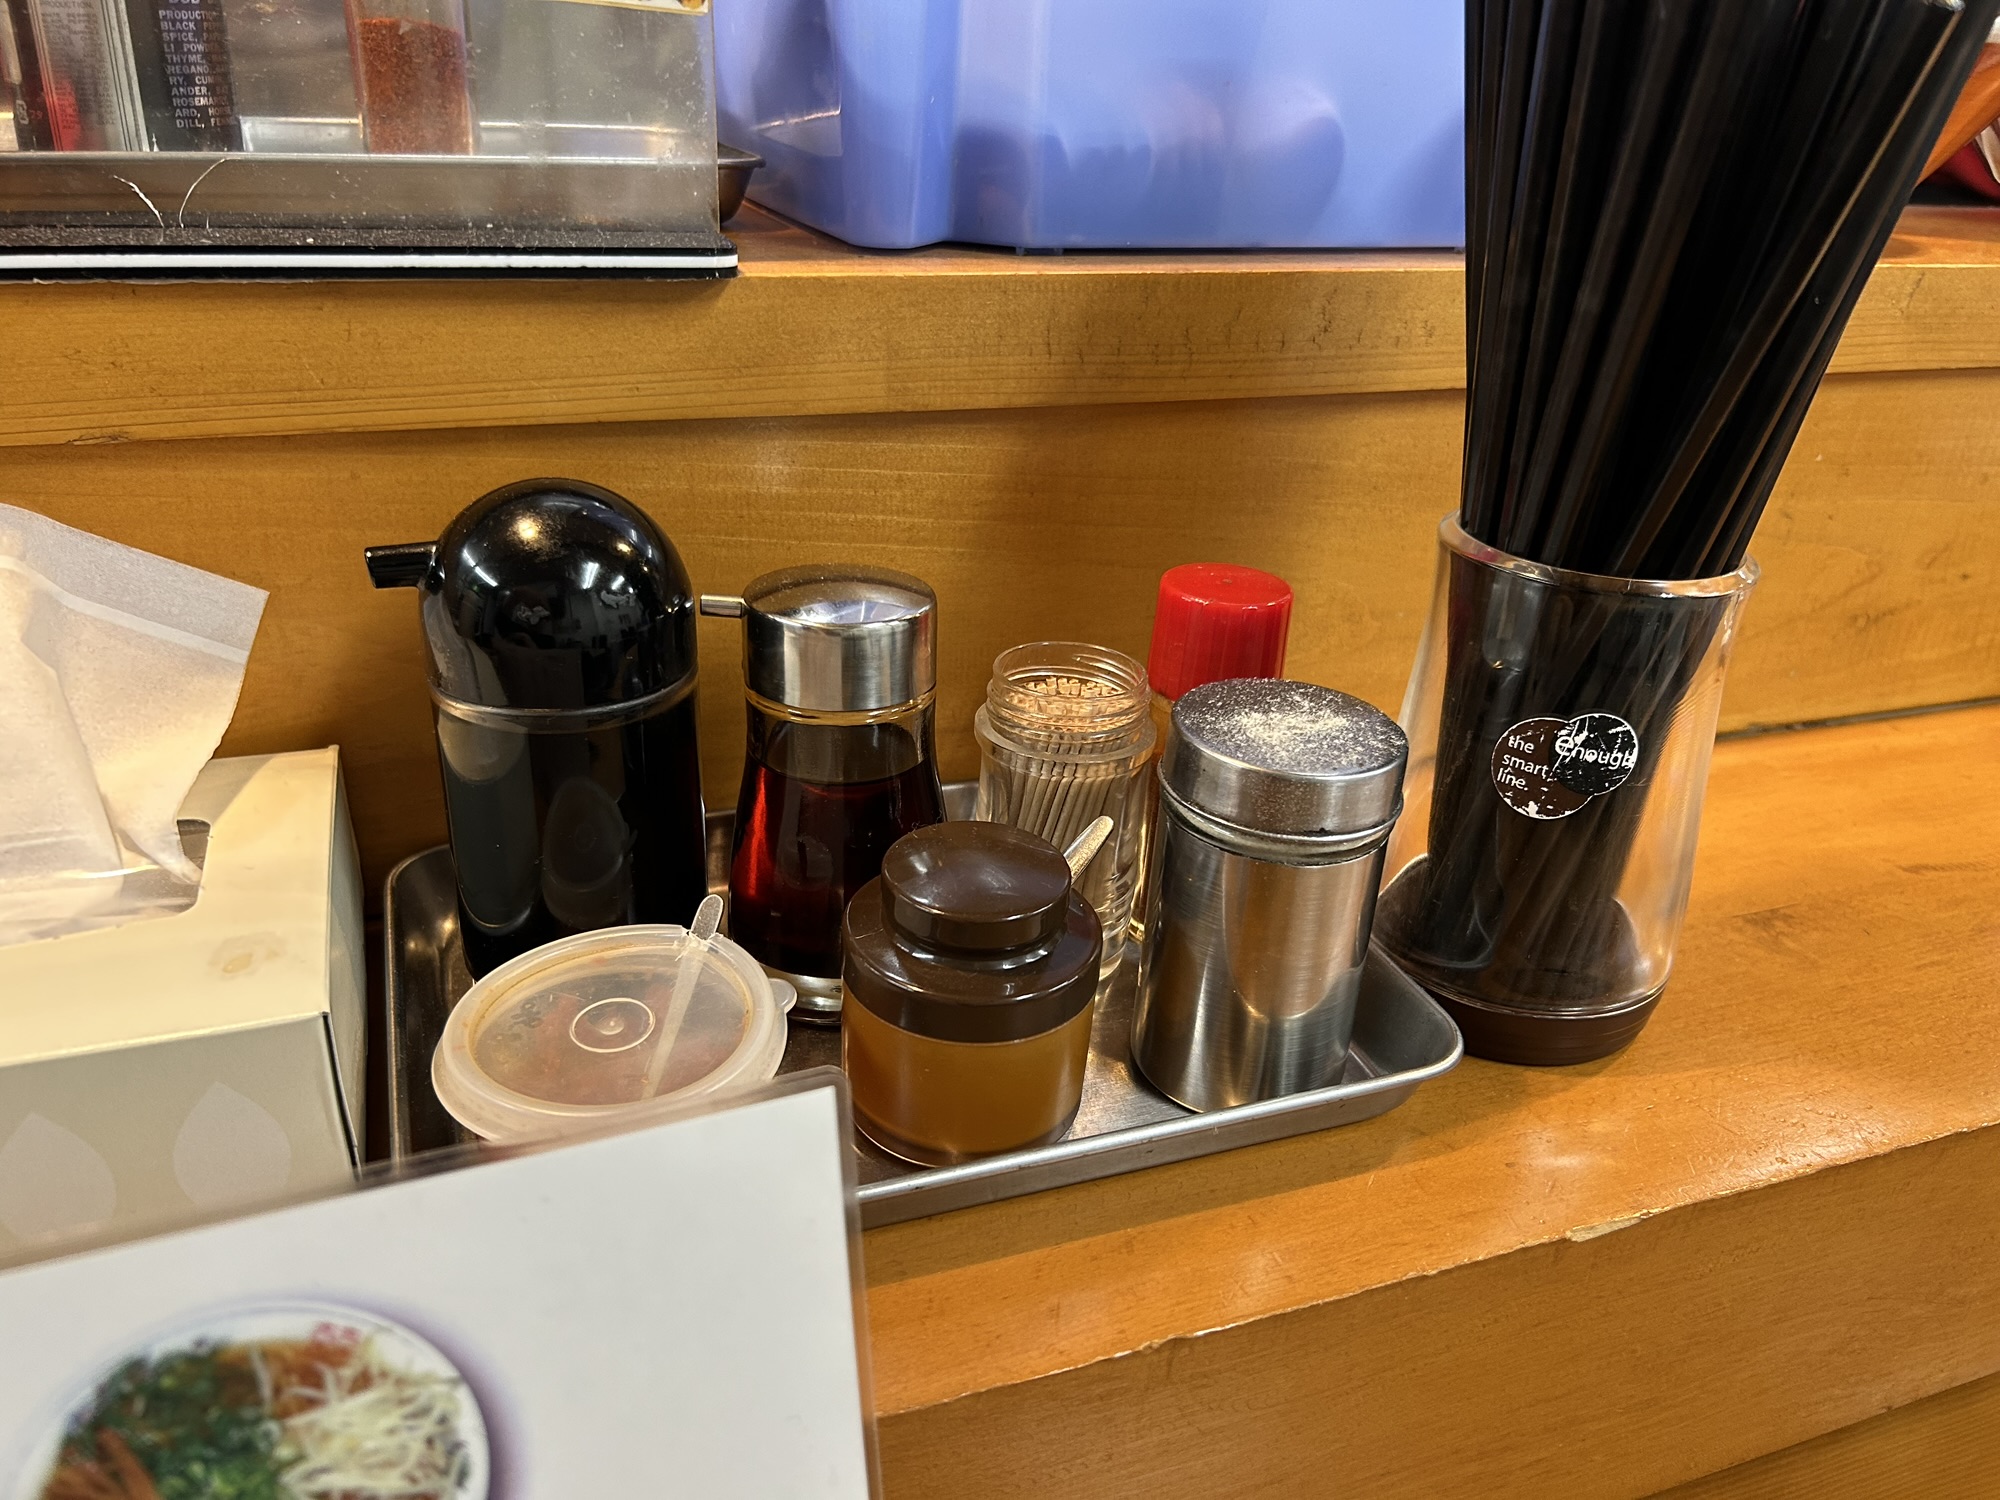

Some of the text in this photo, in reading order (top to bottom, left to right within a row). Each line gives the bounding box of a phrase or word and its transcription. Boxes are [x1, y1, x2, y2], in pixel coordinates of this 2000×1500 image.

[160, 21, 196, 31] BLACK
[162, 32, 198, 42] SPICE,
[165, 54, 206, 63] THYME,
[169, 75, 187, 86] RY,
[171, 86, 211, 96] ANDER,
[175, 107, 201, 118] ARD,
[176, 118, 205, 129] DILL,
[1507, 735, 1535, 754] the
[1501, 753, 1549, 779] smart
[1496, 767, 1529, 791] line.
